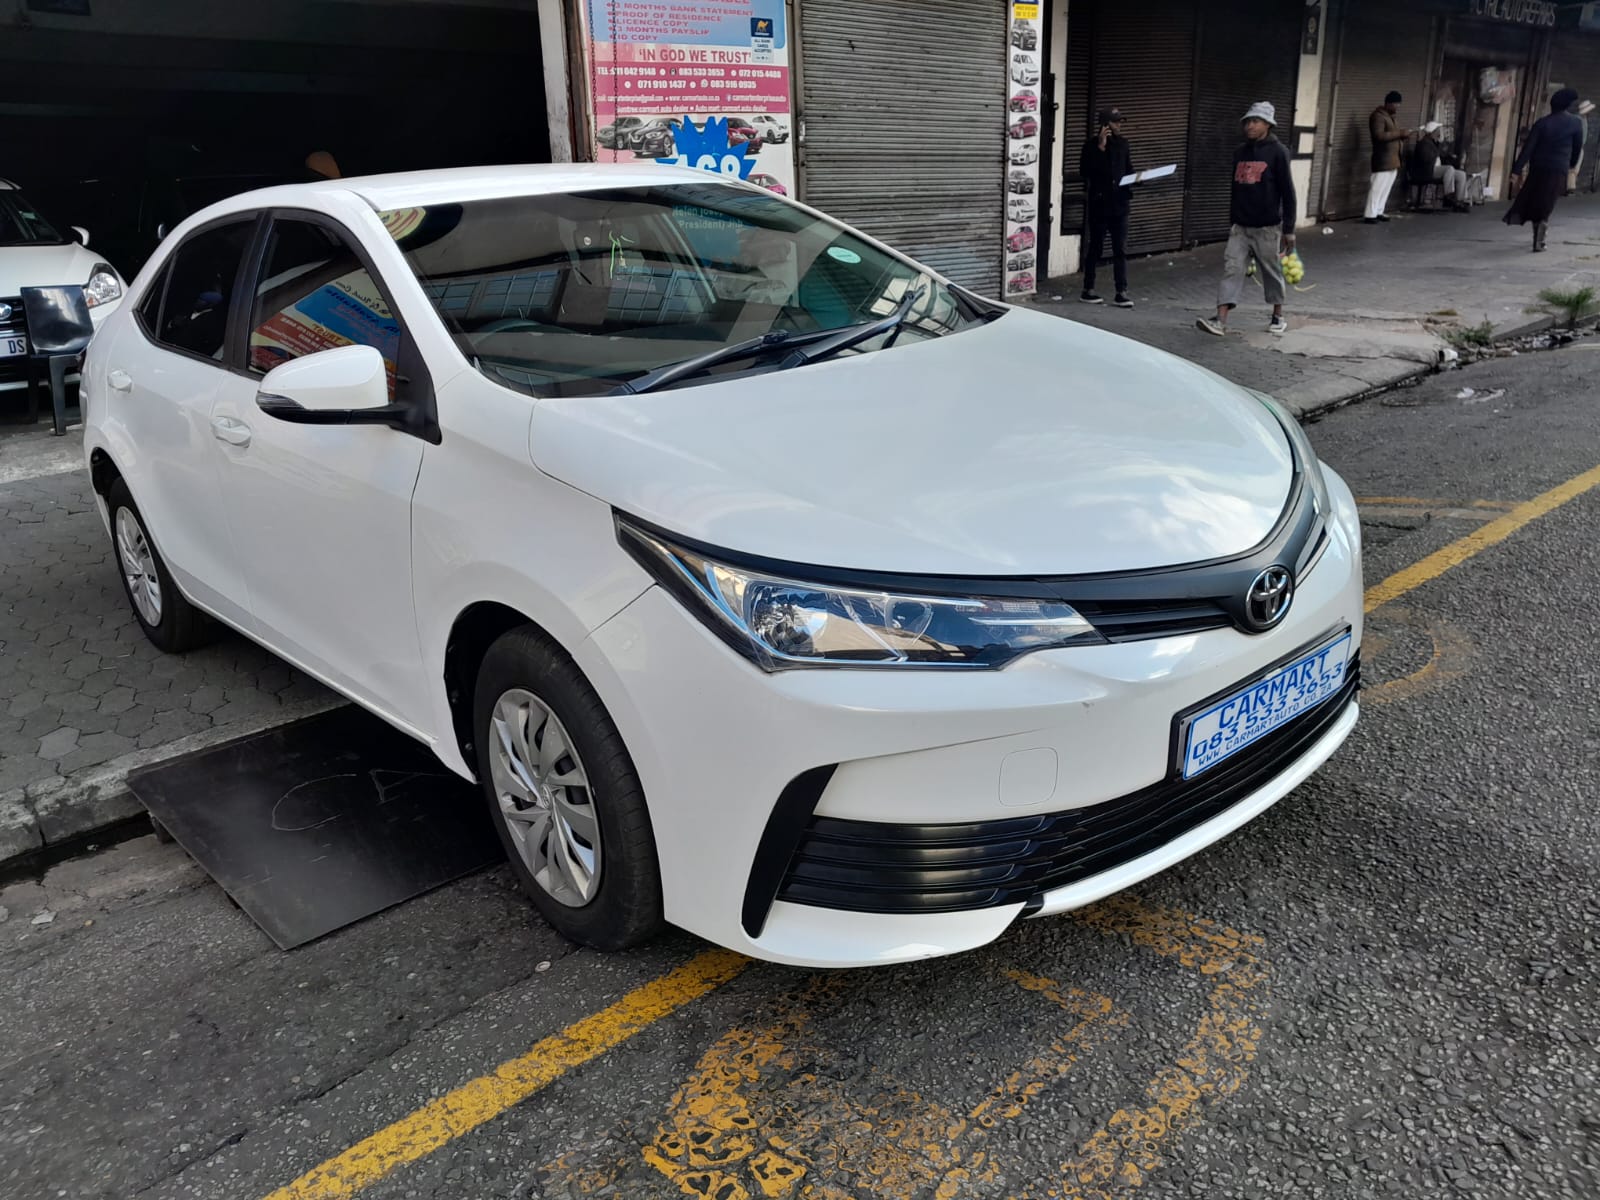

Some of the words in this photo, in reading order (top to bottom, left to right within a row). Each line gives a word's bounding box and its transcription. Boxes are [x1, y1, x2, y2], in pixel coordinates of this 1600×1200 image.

[624, 3, 667, 11] MONTHS
[701, 7, 754, 16] STATEMENT
[616, 18, 660, 26] LICENCE
[669, 13, 721, 22] RESIDENCE
[626, 26, 669, 34] MONTHS
[660, 49, 685, 62] GOD
[689, 50, 708, 62] WE
[8, 339, 25, 354] DS
[1219, 650, 1330, 729] CARMART
[1193, 722, 1239, 760] 083
[1245, 695, 1287, 730] 533
[1293, 662, 1343, 703] 3653
